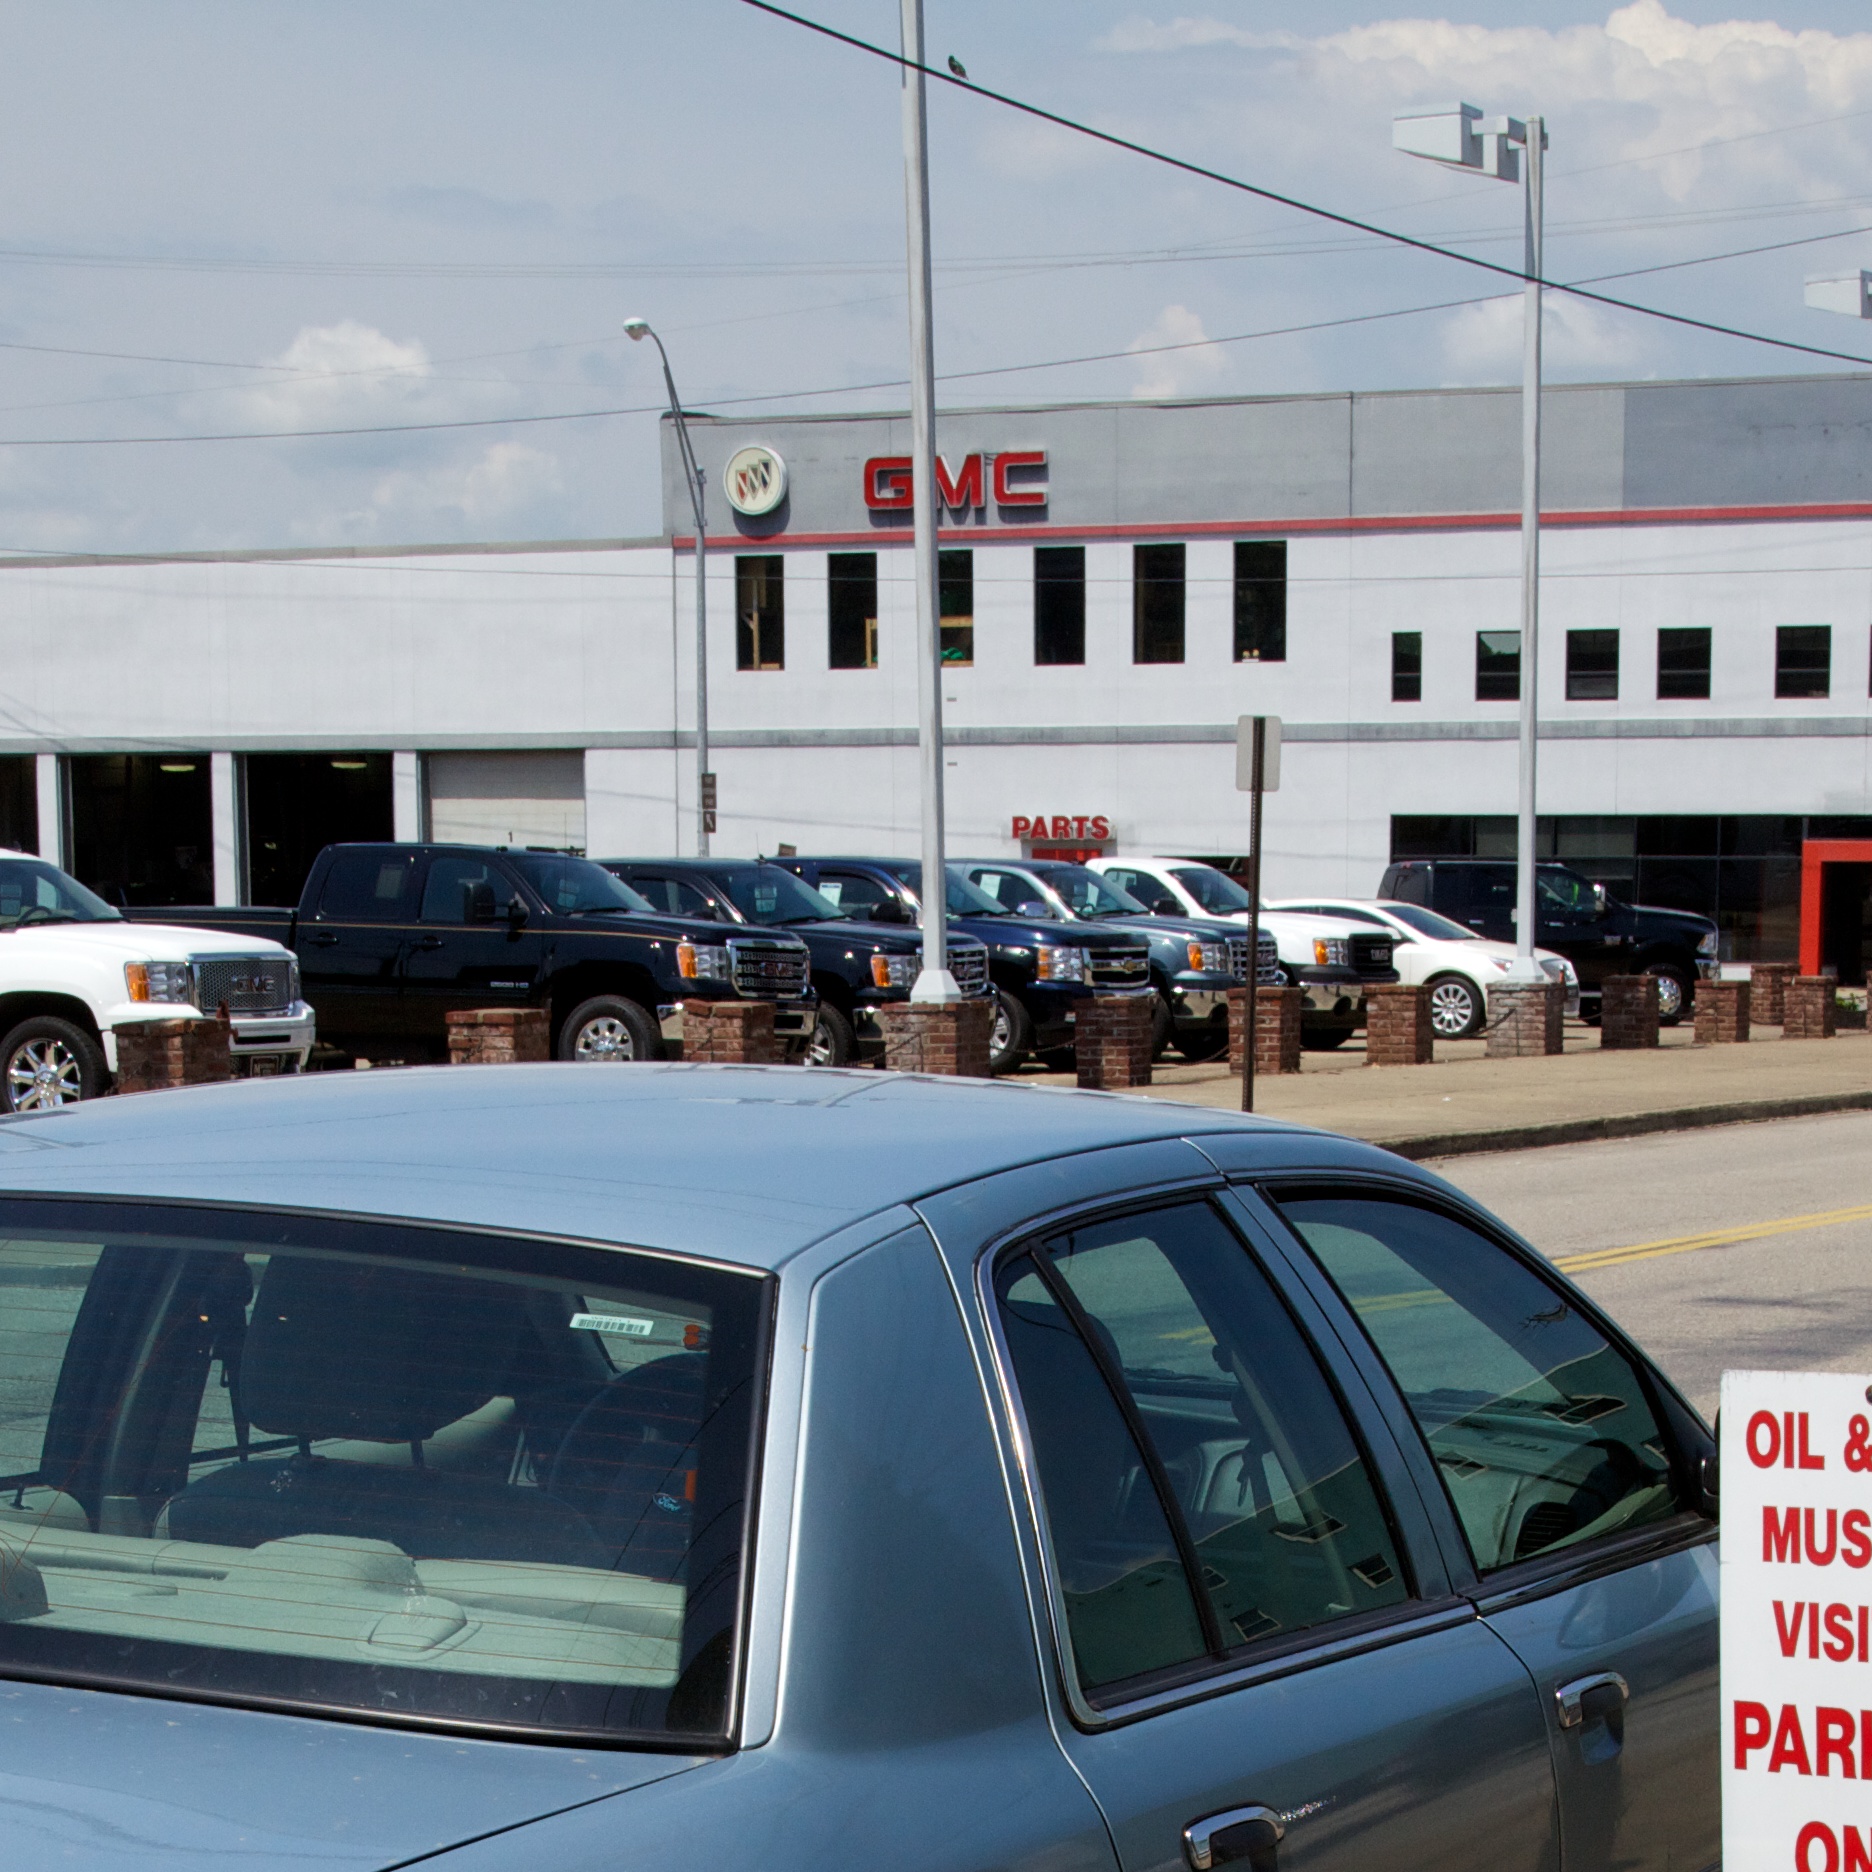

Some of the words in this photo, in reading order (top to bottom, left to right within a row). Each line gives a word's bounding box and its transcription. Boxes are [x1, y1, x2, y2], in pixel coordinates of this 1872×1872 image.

[864, 450, 1049, 510] GMC
[1011, 815, 1110, 840] PARTS
[1745, 1409, 1825, 1470] OIL
